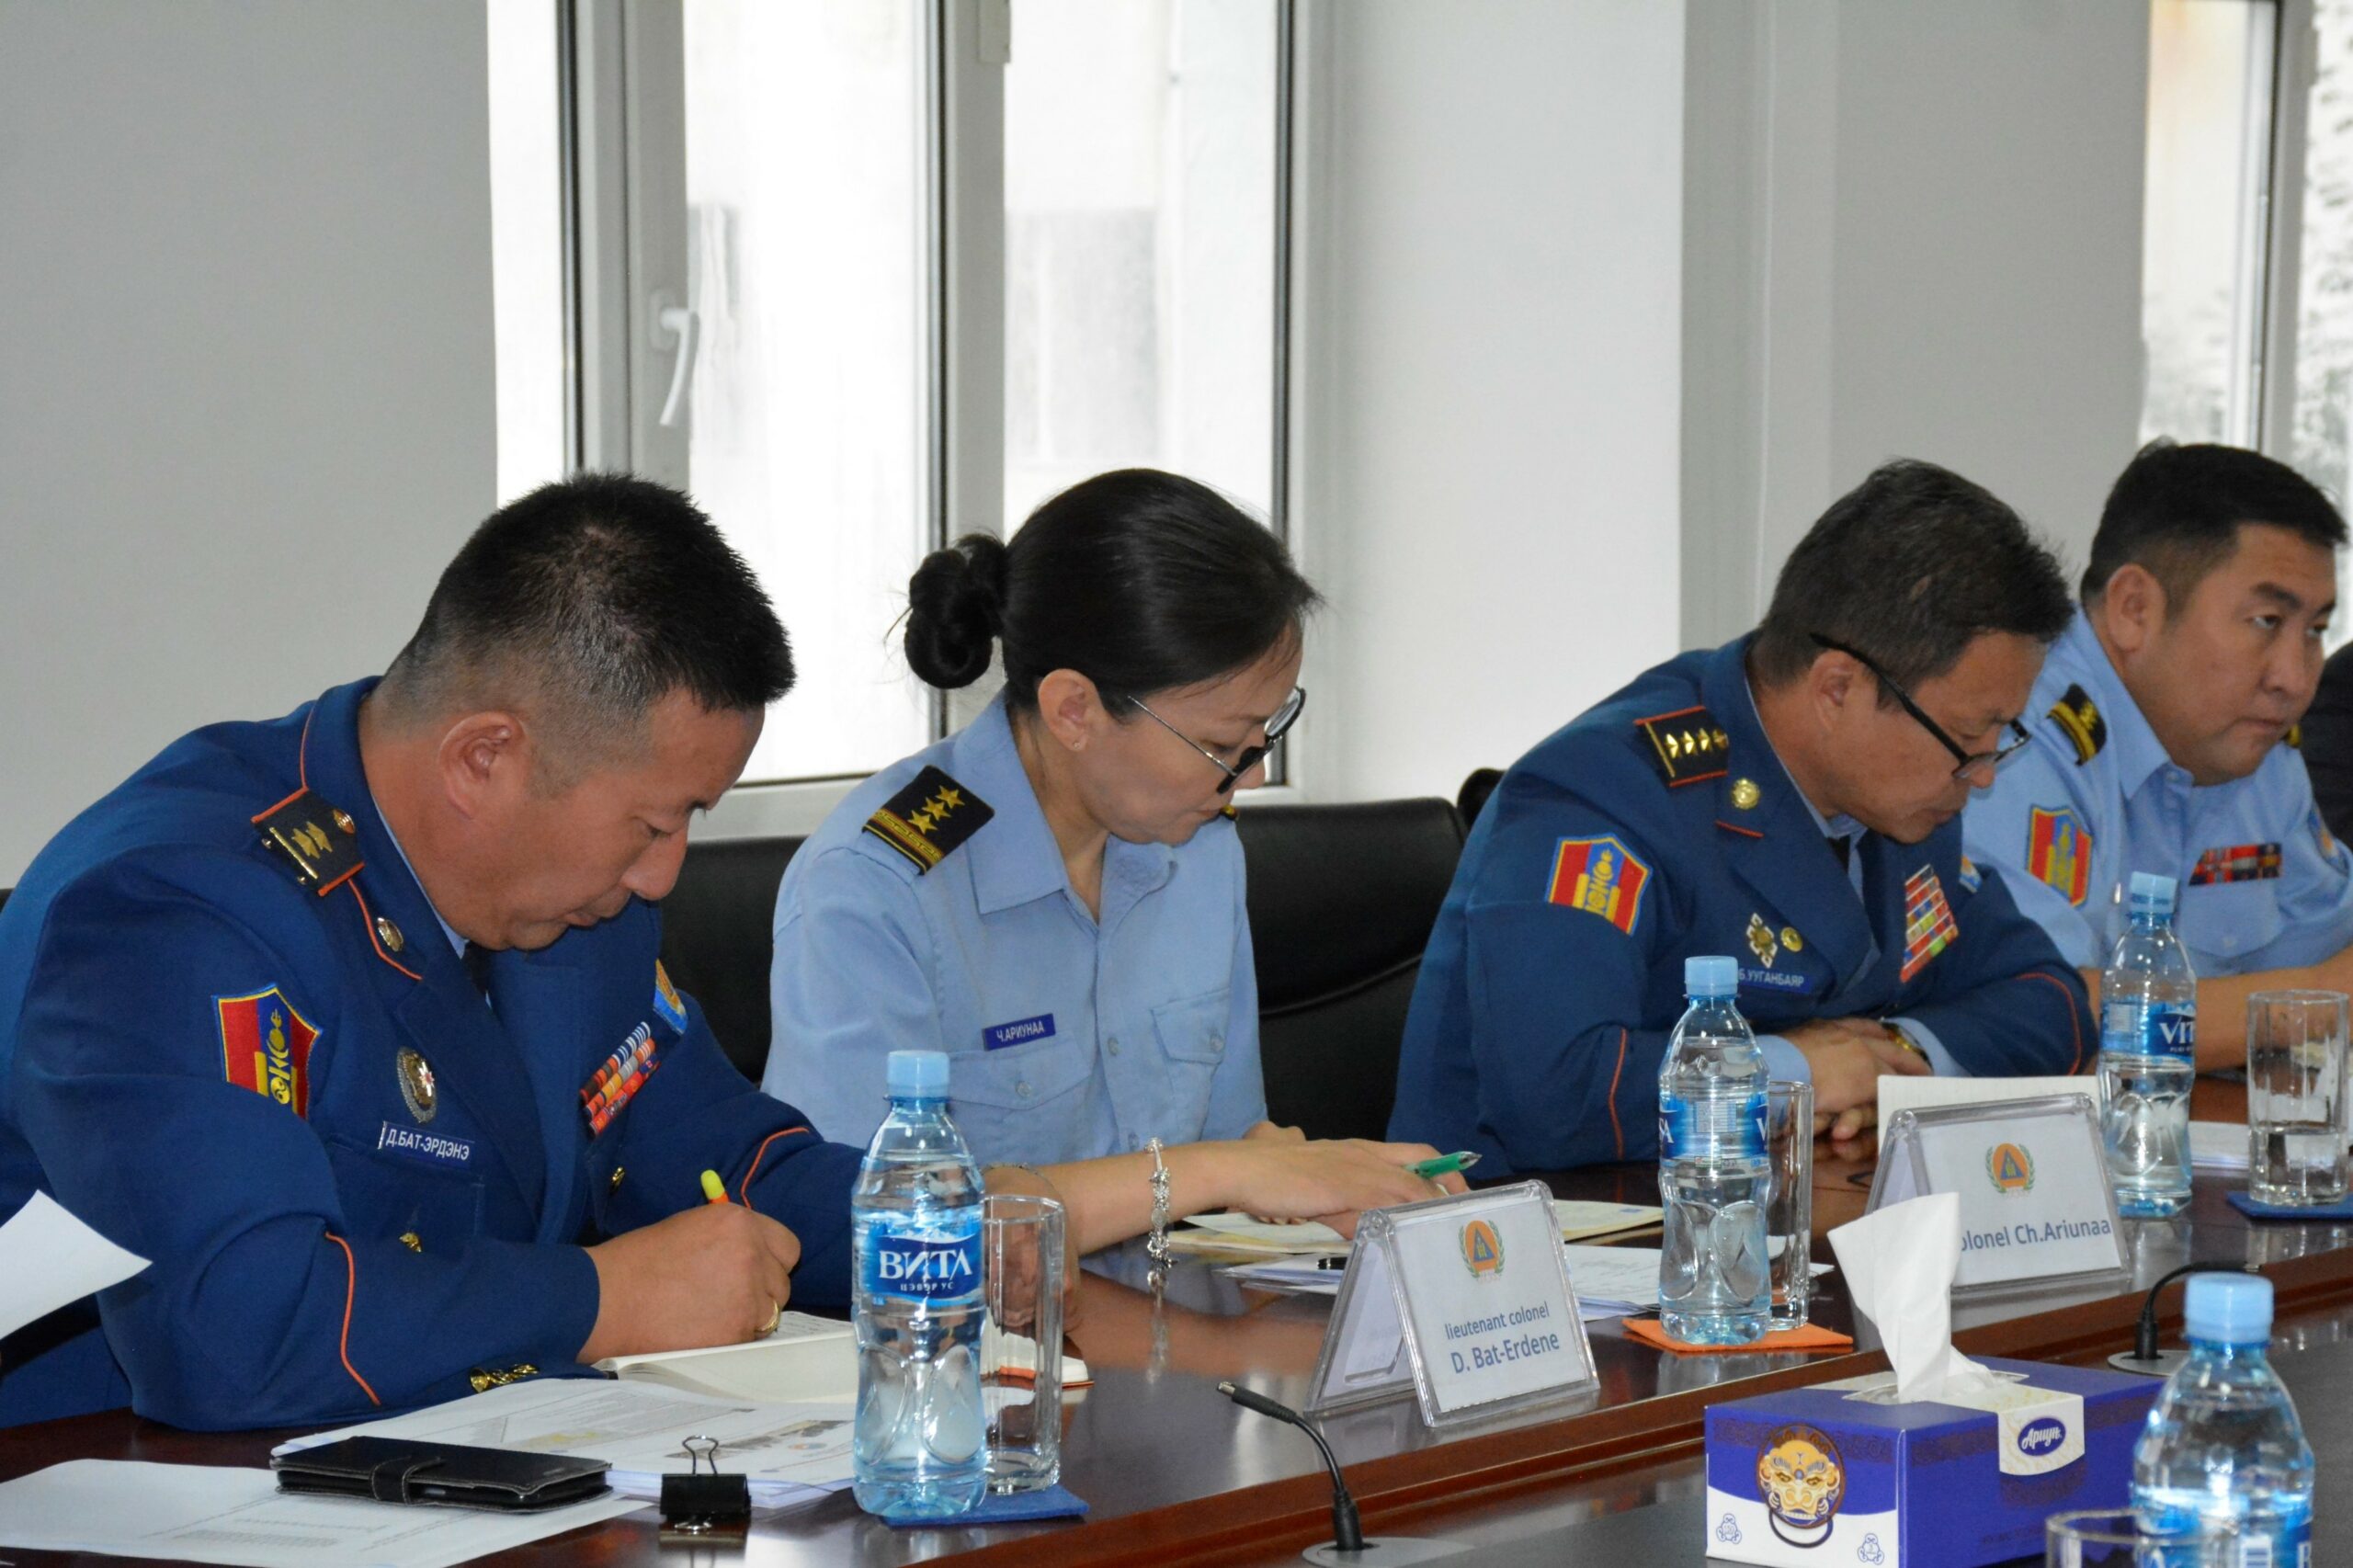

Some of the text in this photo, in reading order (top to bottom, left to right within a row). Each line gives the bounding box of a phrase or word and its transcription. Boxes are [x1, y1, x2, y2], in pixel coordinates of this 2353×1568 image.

[995, 1020, 1045, 1042] Ч.АРИУНАА
[385, 1129, 470, 1160] Д.БАТ-ЭРДЭНЭ
[1961, 1220, 2111, 1252] lonel Ch.Ariunaa
[1444, 1301, 1550, 1340] lieutenant colonel
[1450, 1333, 1560, 1374] D. Bat-Erdene
